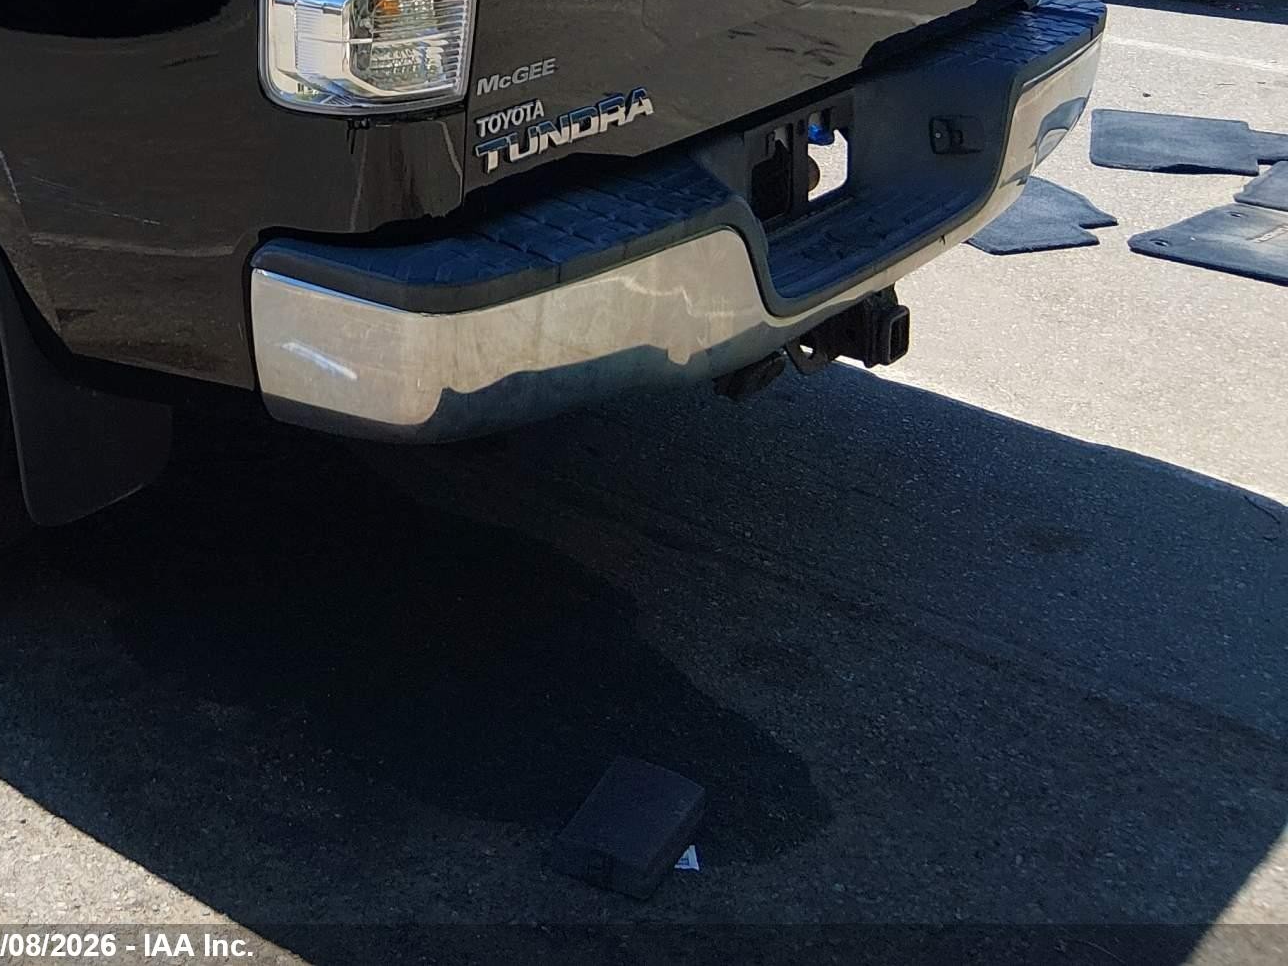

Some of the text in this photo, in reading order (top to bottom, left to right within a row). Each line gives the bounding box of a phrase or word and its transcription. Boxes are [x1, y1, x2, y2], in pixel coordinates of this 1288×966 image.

[476, 57, 557, 96] McGEE
[476, 100, 545, 138] TOYOTA
[476, 86, 655, 174] TUNDRA
